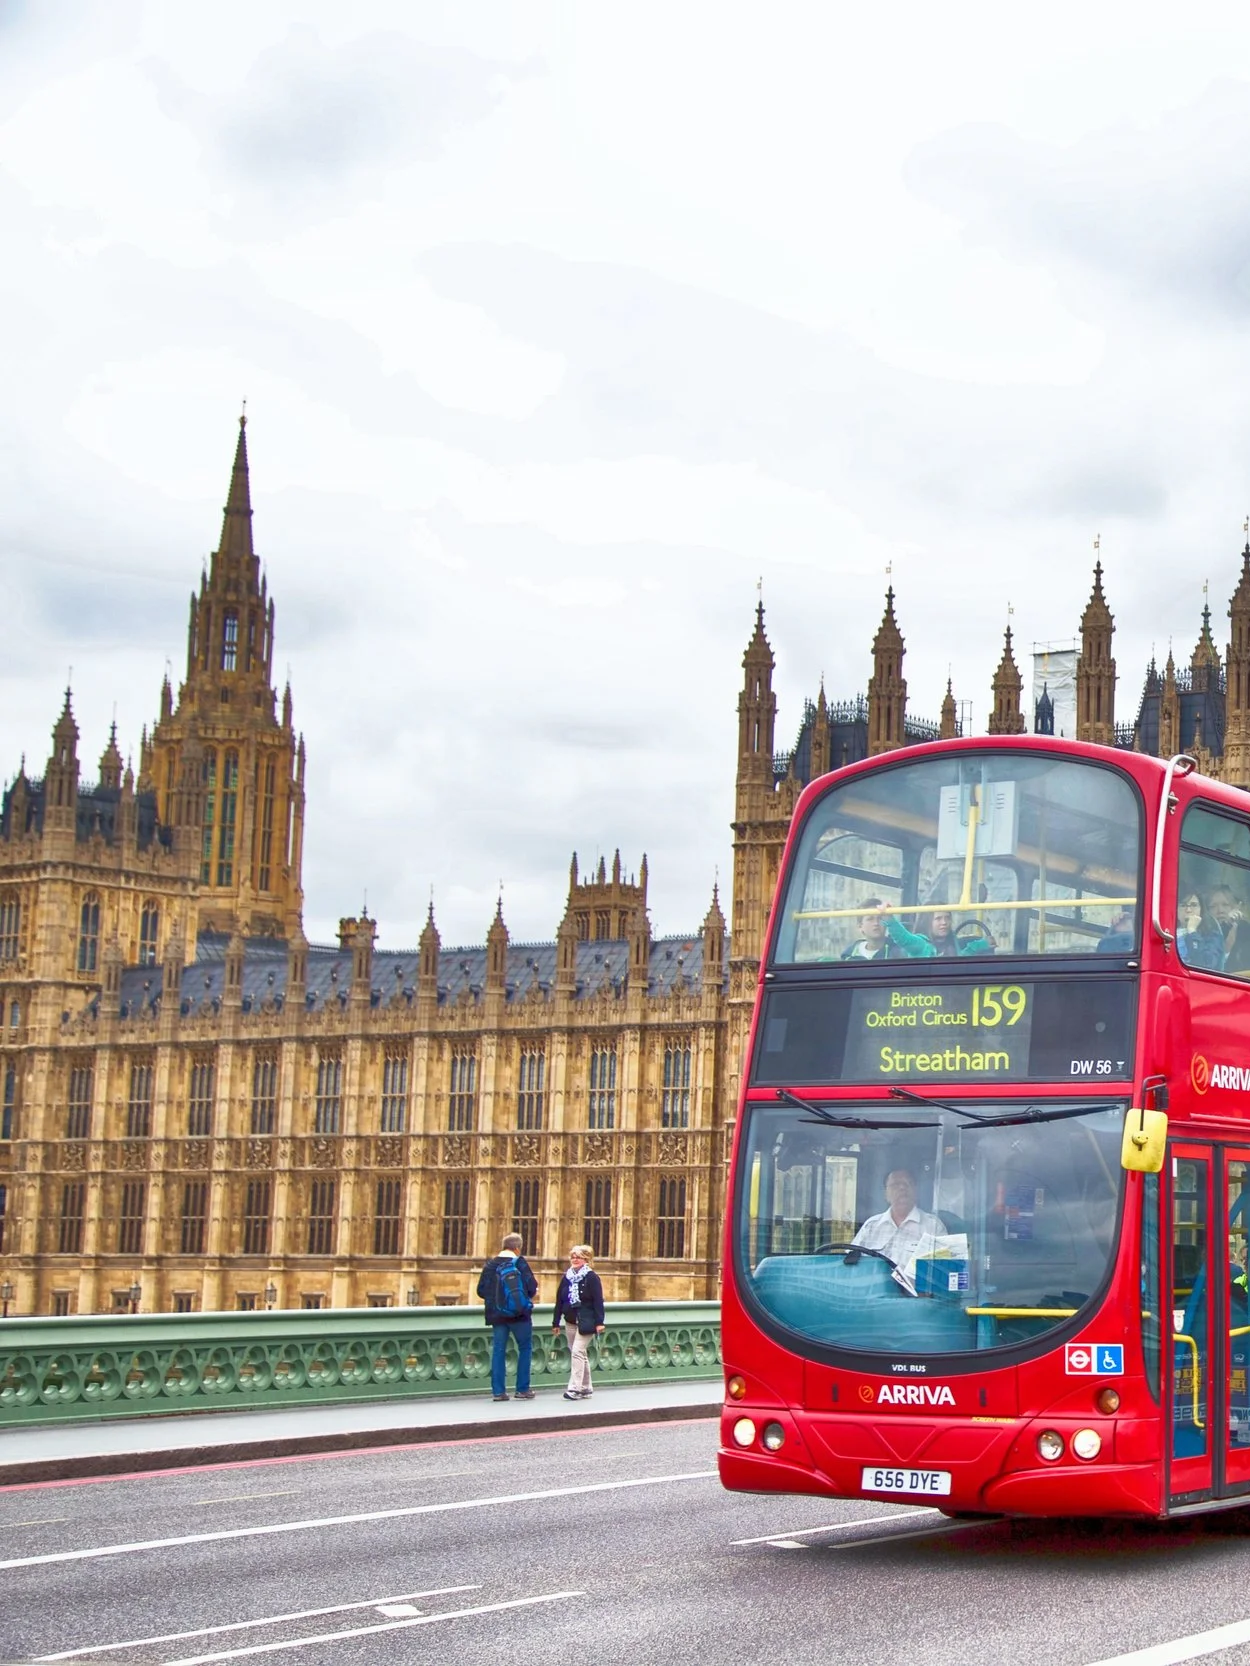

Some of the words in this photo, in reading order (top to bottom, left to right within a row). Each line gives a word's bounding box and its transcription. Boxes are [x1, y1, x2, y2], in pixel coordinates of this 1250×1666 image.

[891, 992, 942, 1007] Brixton
[972, 986, 1026, 1027] 159
[866, 1011, 916, 1028] Oxford
[922, 1009, 967, 1025] Circus
[880, 1045, 1010, 1073] Streatham
[1070, 1060, 1094, 1075] DW
[1096, 1060, 1111, 1075] 56
[892, 1364, 908, 1372] VDL
[909, 1364, 926, 1373] BUS
[877, 1385, 956, 1405] ARRIVA
[874, 1470, 905, 1488] 656
[909, 1472, 940, 1491] DYE
